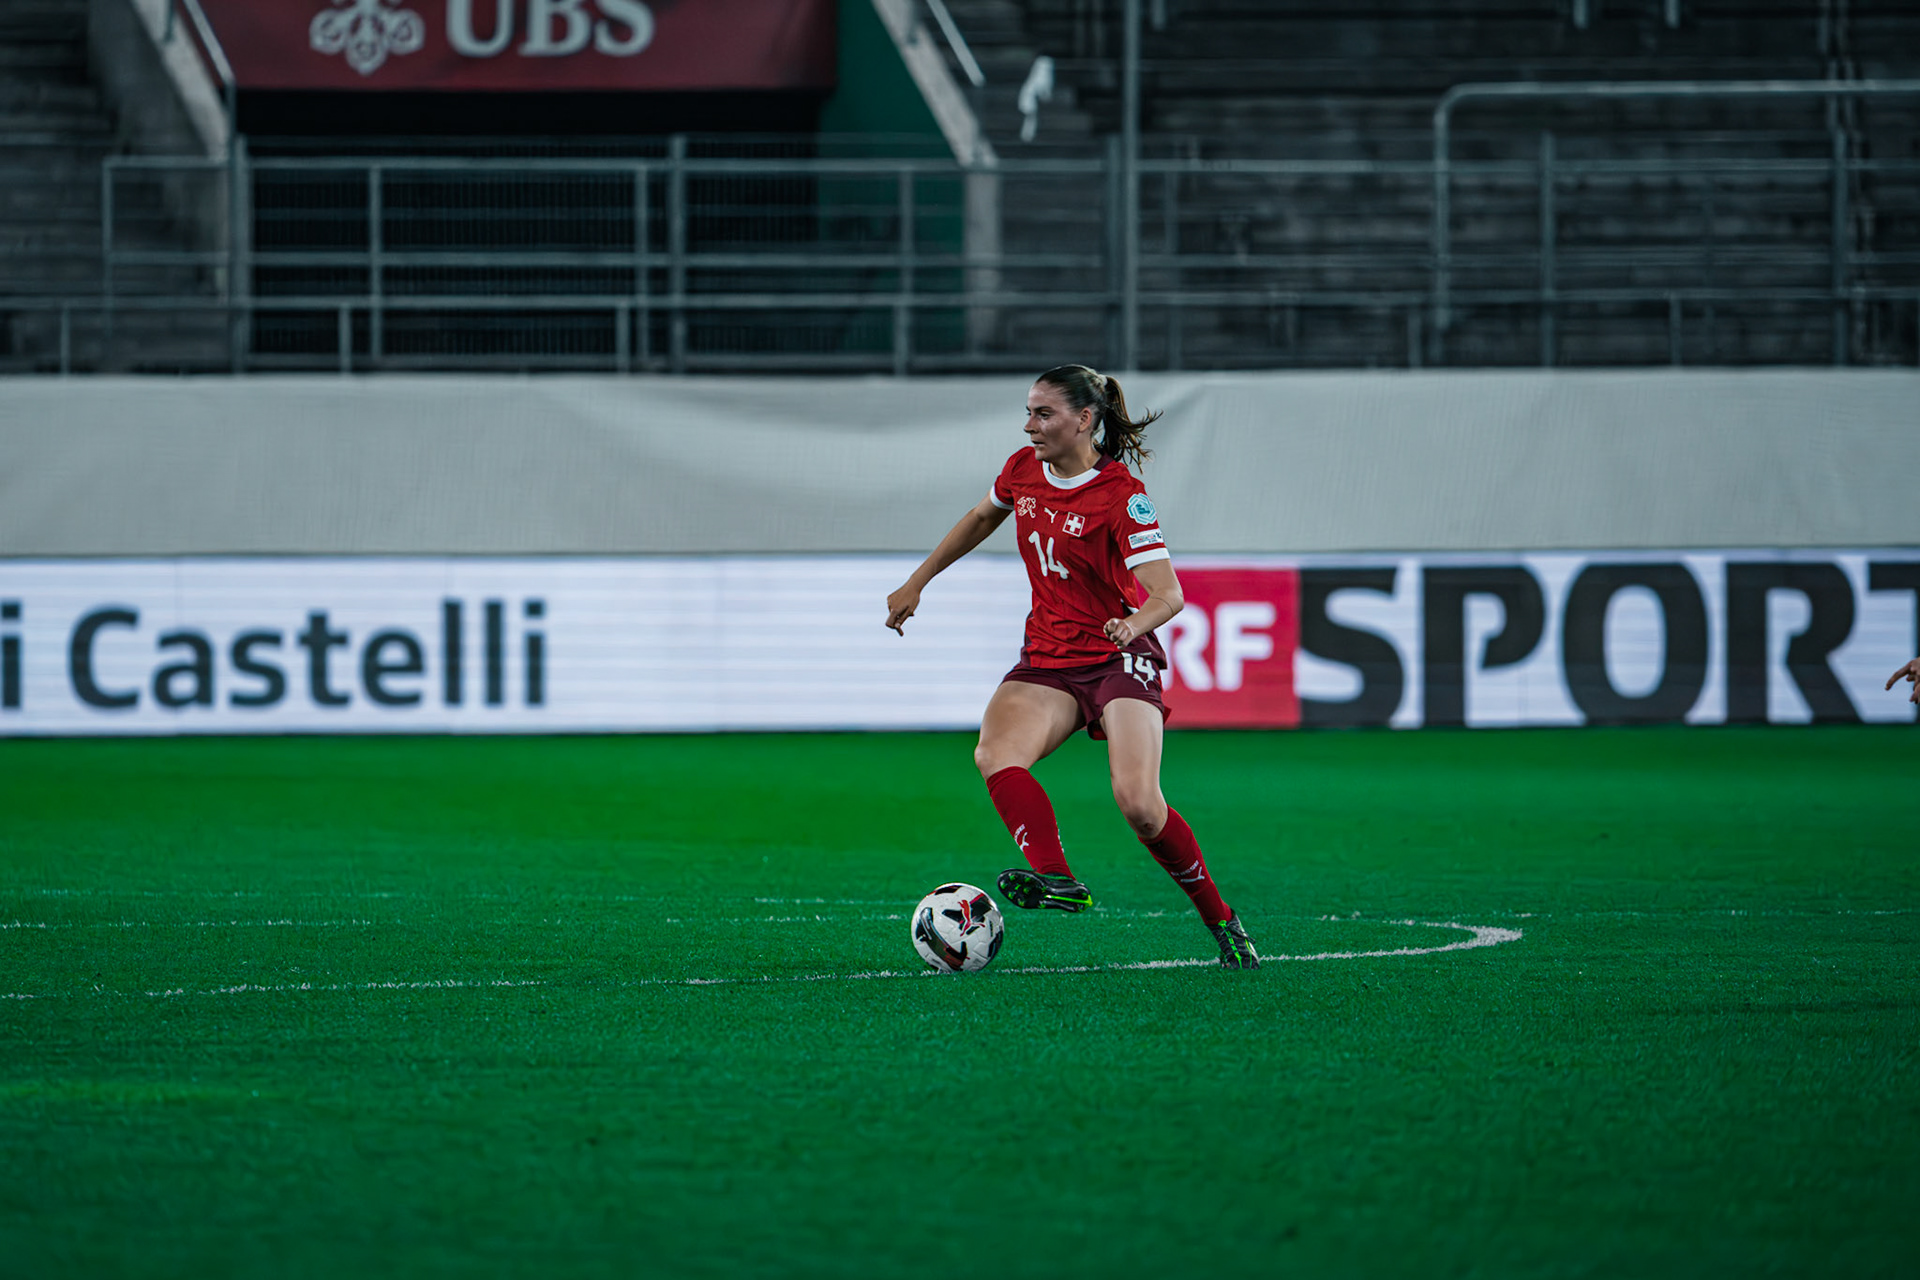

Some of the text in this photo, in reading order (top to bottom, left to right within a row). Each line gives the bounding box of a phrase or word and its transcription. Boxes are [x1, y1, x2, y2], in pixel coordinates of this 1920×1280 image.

[445, 0, 655, 57] UBS
[1028, 530, 1070, 580] 14
[68, 598, 546, 710] Castelli
[1121, 652, 1156, 681] 14
[1153, 601, 1277, 692] RF
